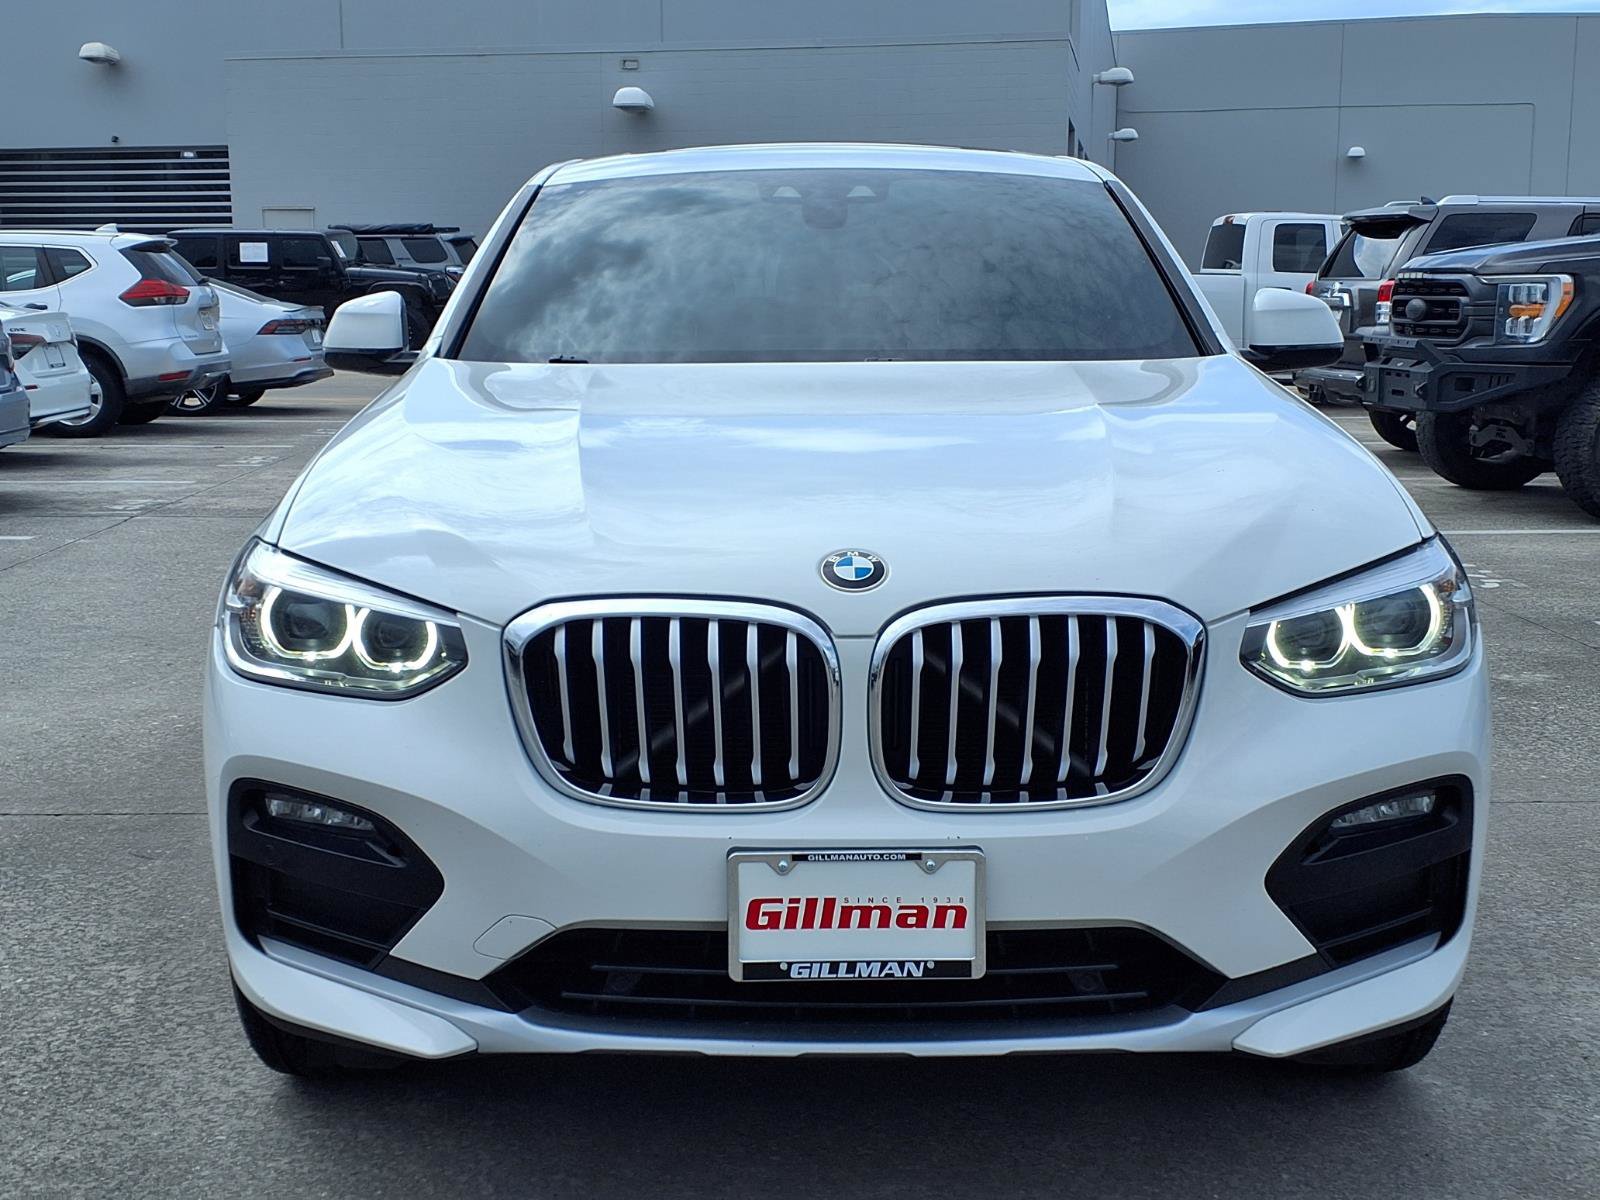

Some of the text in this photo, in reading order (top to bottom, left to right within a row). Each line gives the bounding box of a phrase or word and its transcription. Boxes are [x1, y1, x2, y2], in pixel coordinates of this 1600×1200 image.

[828, 551, 880, 563] BMW
[807, 852, 907, 862] GILLMANAUTO.COM
[843, 896, 965, 904] SINCE 1938
[745, 897, 968, 930] Gillman
[789, 961, 925, 979] GILLMAN
